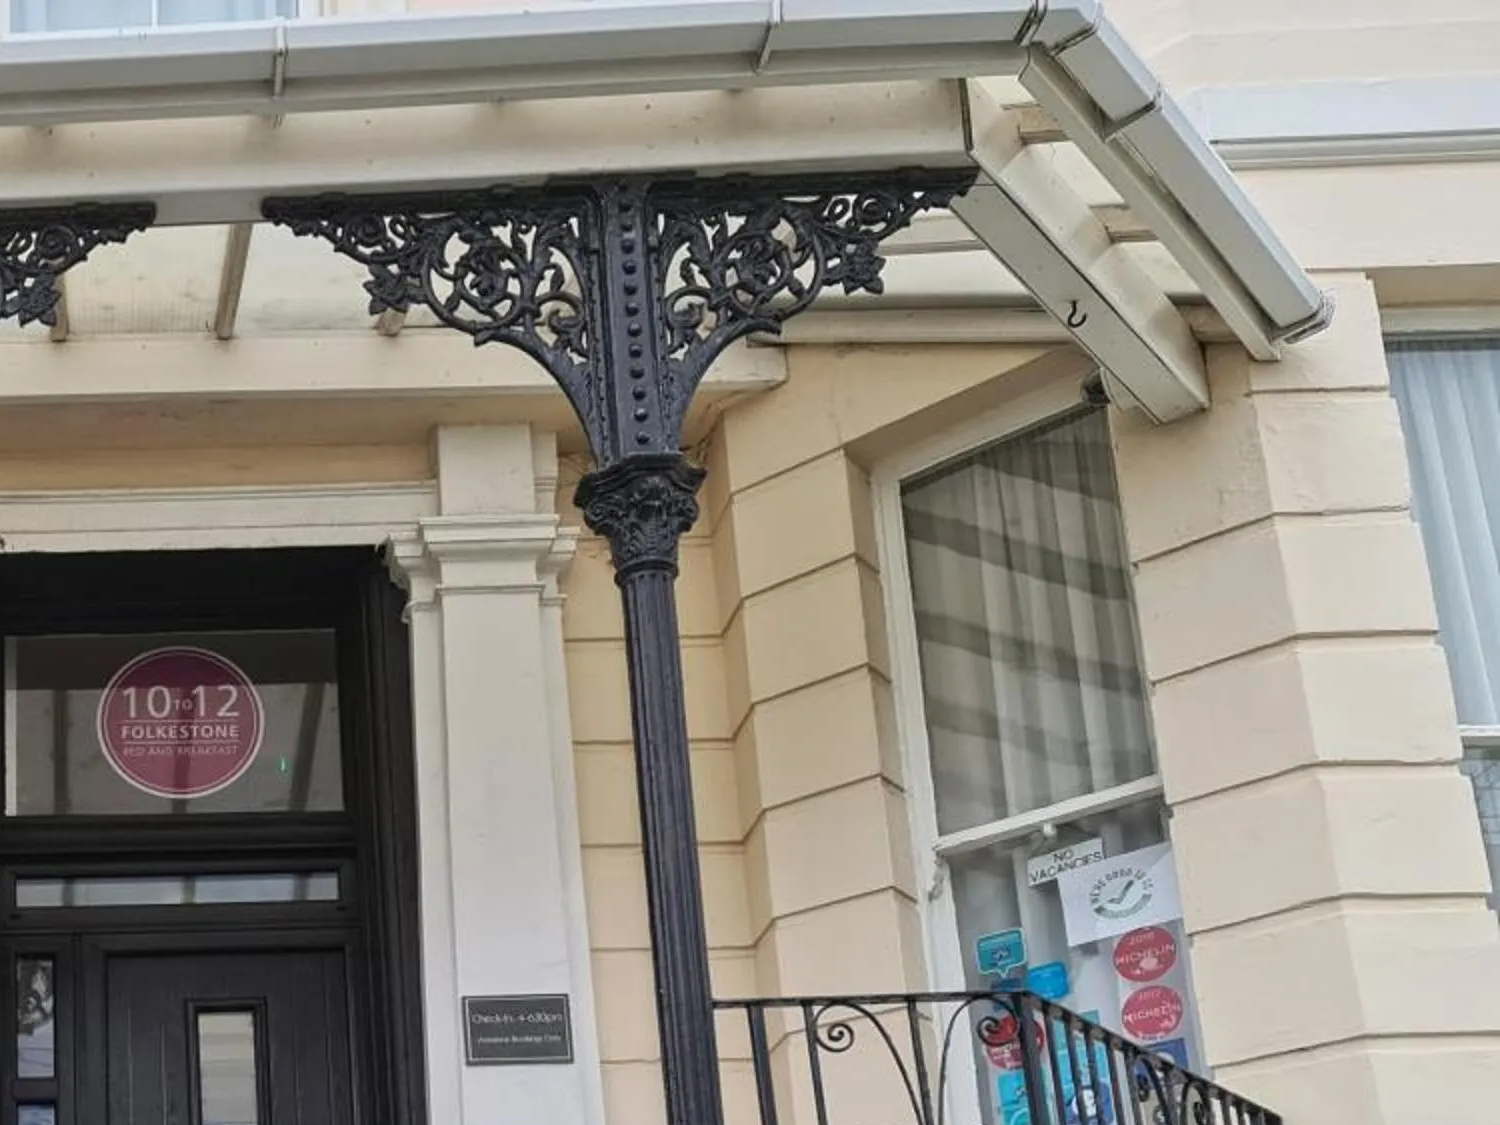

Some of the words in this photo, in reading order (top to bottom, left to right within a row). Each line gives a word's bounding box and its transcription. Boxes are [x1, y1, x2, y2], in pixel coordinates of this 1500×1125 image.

[122, 685, 171, 719] 10
[192, 684, 239, 718] 12
[121, 724, 240, 739] FOLKESTONE
[1029, 851, 1102, 882] VACANCIES
[1053, 848, 1074, 863] NO
